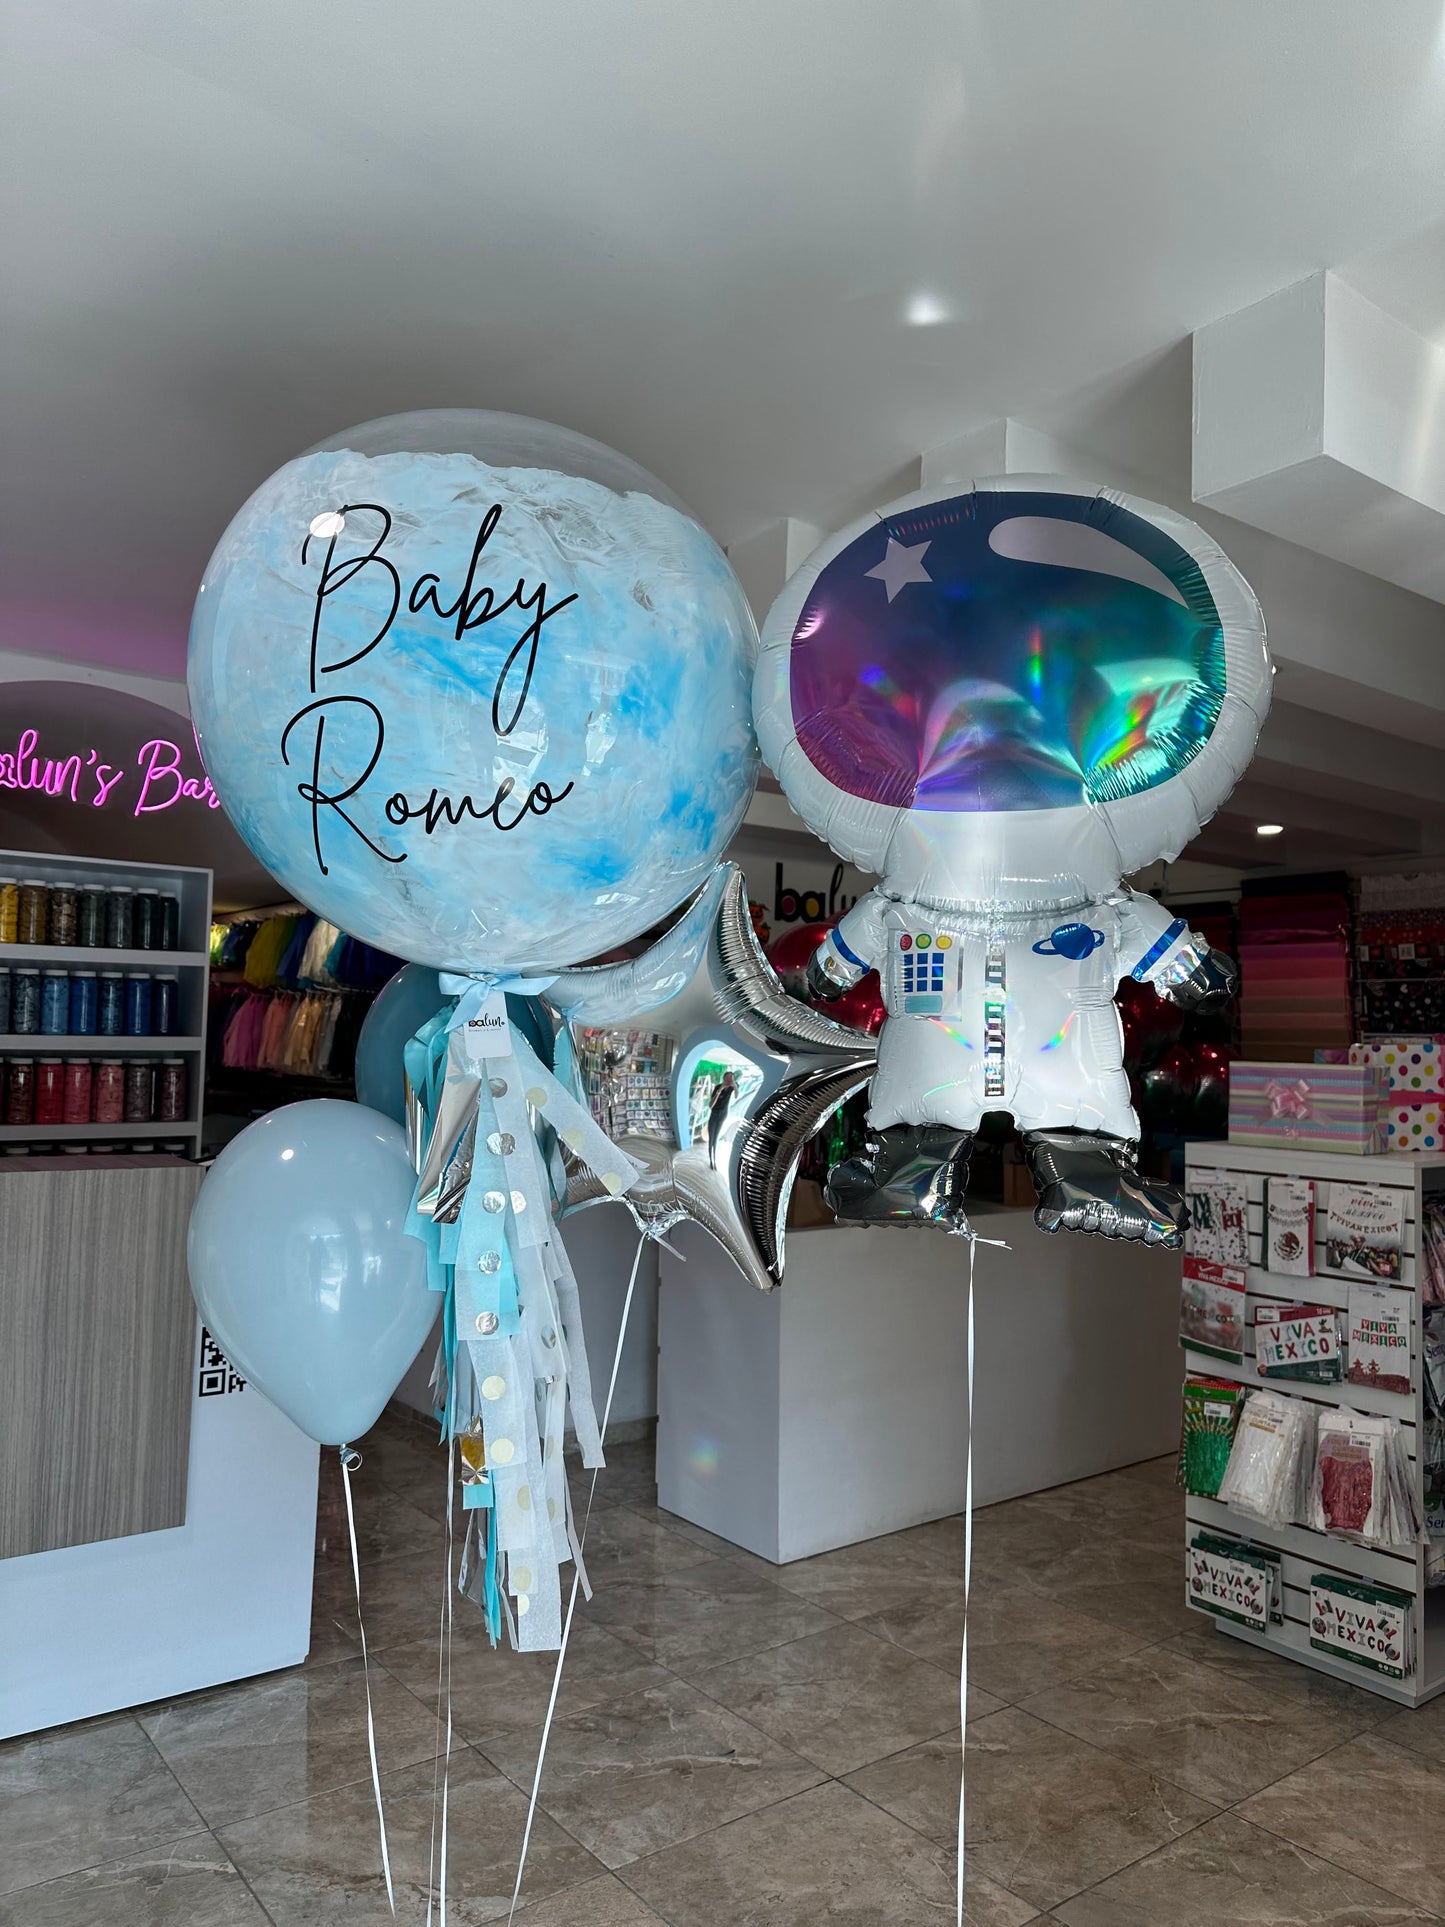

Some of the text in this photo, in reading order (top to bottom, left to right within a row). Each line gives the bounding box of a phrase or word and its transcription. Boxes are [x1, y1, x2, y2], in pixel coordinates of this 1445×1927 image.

[302, 503, 579, 736] Baby
[280, 695, 574, 876] Romeo
[1270, 1321, 1315, 1342] VIVA
[1352, 1329, 1407, 1348] MEXICO
[1361, 1319, 1397, 1334] VIVA
[1263, 1337, 1330, 1364] MEXICO
[1210, 1566, 1242, 1589] VIVA
[1203, 1579, 1251, 1608] MEXICO
[1335, 1607, 1376, 1633] VIVA
[1326, 1621, 1385, 1653] MEXICO
